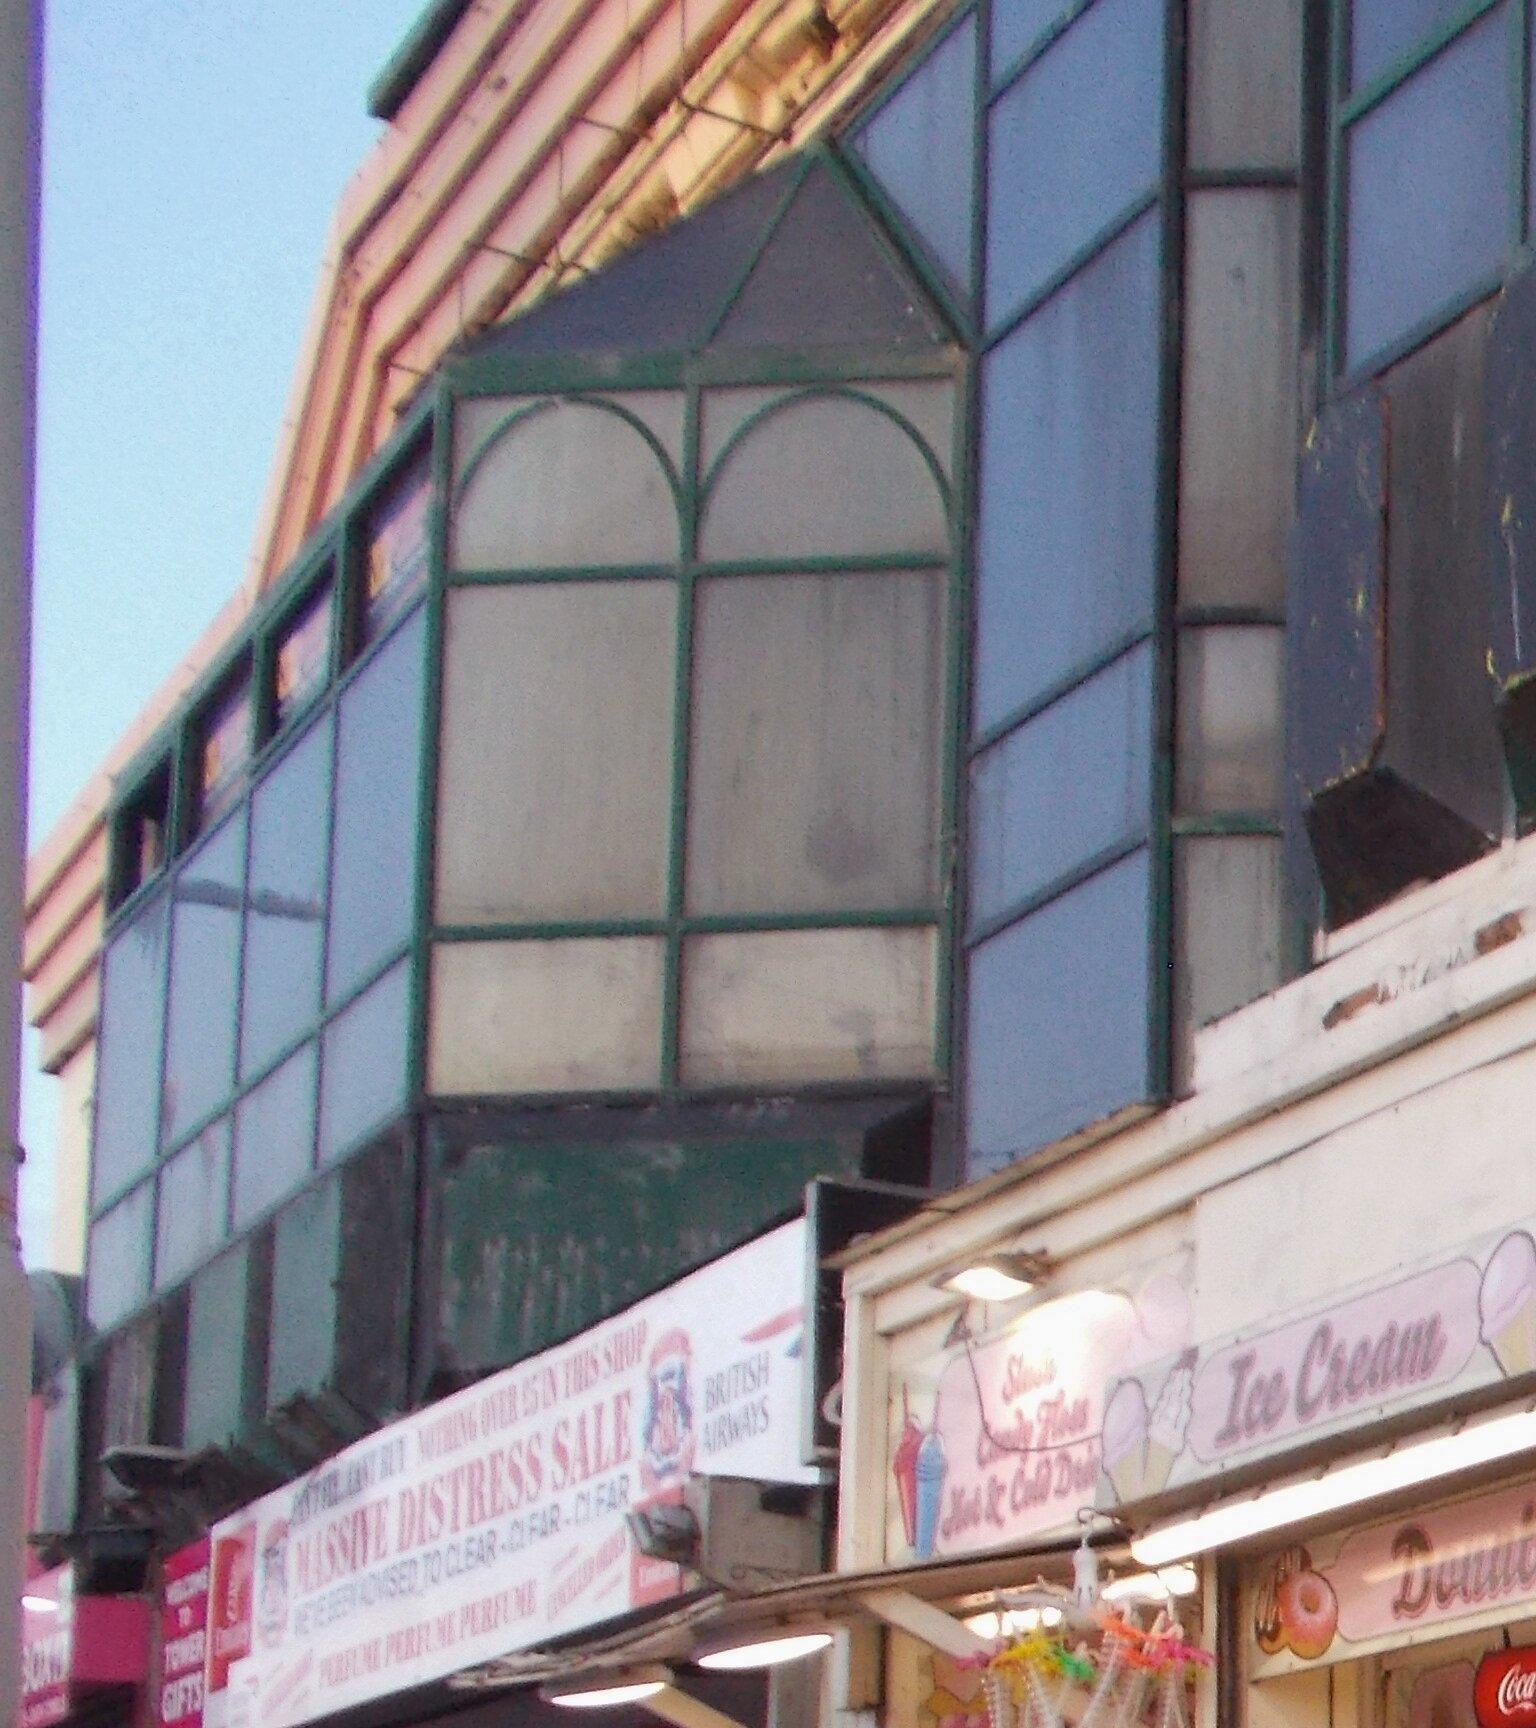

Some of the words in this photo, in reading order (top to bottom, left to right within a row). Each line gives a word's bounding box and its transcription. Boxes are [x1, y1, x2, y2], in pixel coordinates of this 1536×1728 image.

[704, 1350, 771, 1415] BRITISH
[1214, 1348, 1290, 1449] Ice
[1295, 1310, 1448, 1424] Cream
[703, 1396, 770, 1452] AIRWAYS
[298, 1500, 388, 1593] MASSIVE
[397, 1433, 544, 1555] DISTRESS
[552, 1388, 633, 1492] SALE
[445, 1525, 496, 1581] CLEAR
